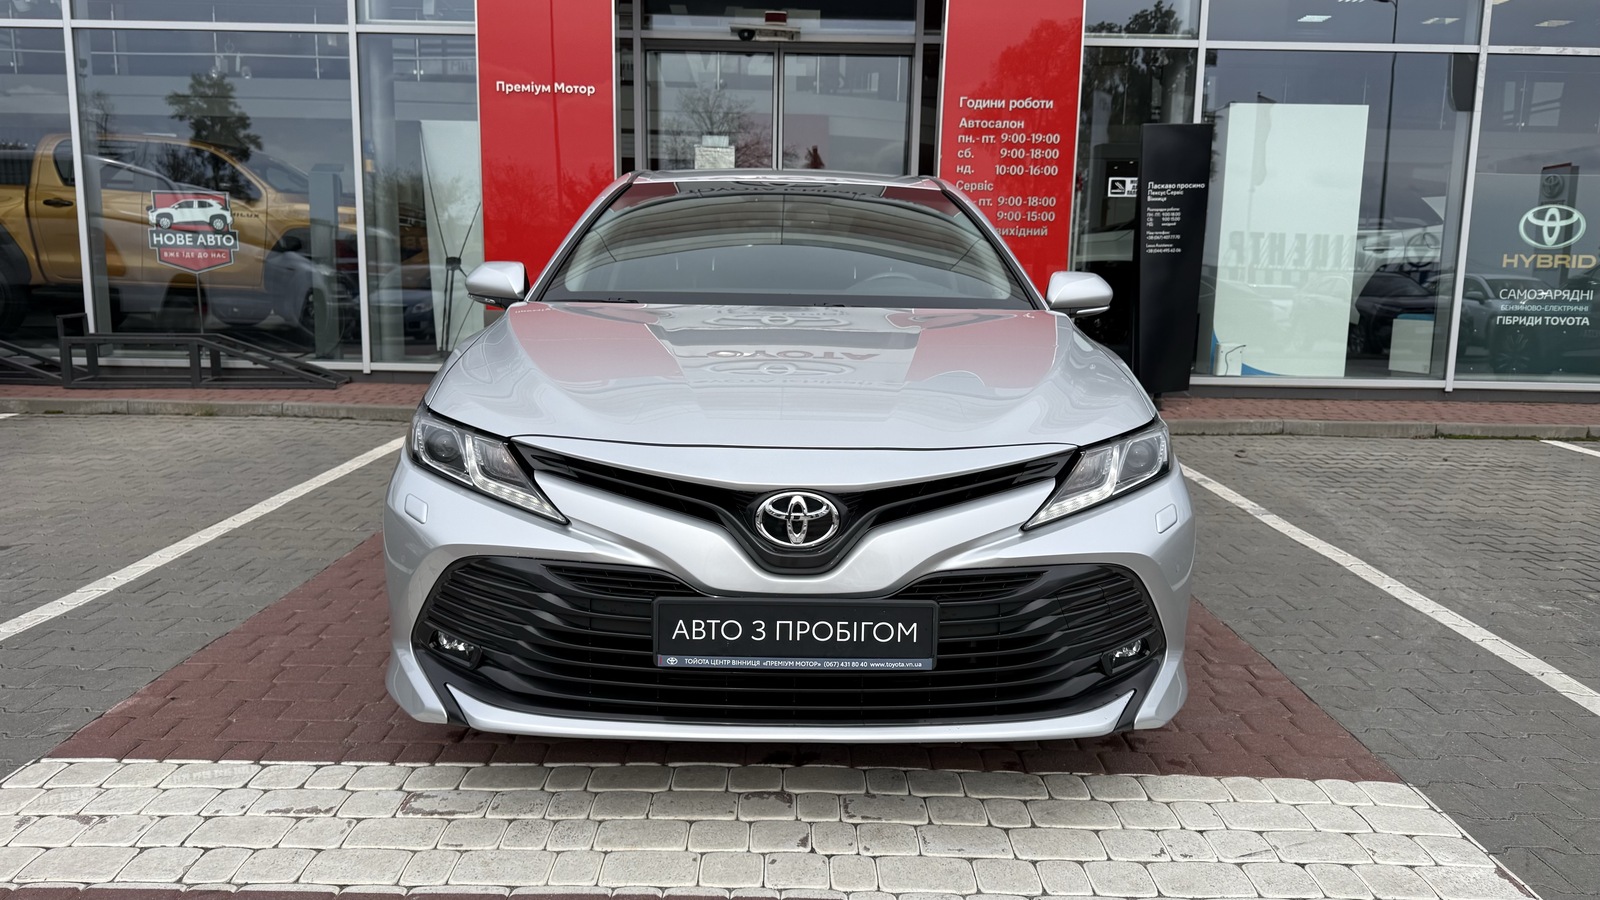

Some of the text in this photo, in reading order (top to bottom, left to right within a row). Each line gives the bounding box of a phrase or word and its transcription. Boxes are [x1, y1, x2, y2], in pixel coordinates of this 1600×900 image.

[495, 80, 596, 97] Преміум Мотор
[959, 96, 1054, 112] Години роботи
[958, 117, 1025, 129] Автосалон
[957, 147, 975, 159] сб.
[956, 165, 975, 175] нд.
[955, 180, 994, 192] Сервіс
[1148, 181, 1176, 189] Ласкаво
[153, 233, 235, 247] НОВЕ АВТО
[163, 250, 227, 260] ВЖЕ ЇДЕ ДО НАС
[1501, 253, 1598, 270] HYBRID
[1499, 289, 1594, 302] САМОЗАРЯДНІ
[1500, 304, 1590, 313] БЕНЗИНОВО-ЕЛЕКТРИЧНІ
[1496, 315, 1591, 327] ГІБРИДИ TOYOTA
[671, 619, 918, 643] АВТО З ПРОБІГОМ
[684, 657, 710, 665] ТОЙОТА
[731, 659, 761, 667] ВІННИЦЯ
[869, 661, 923, 669] www.toyota.vn.ua
